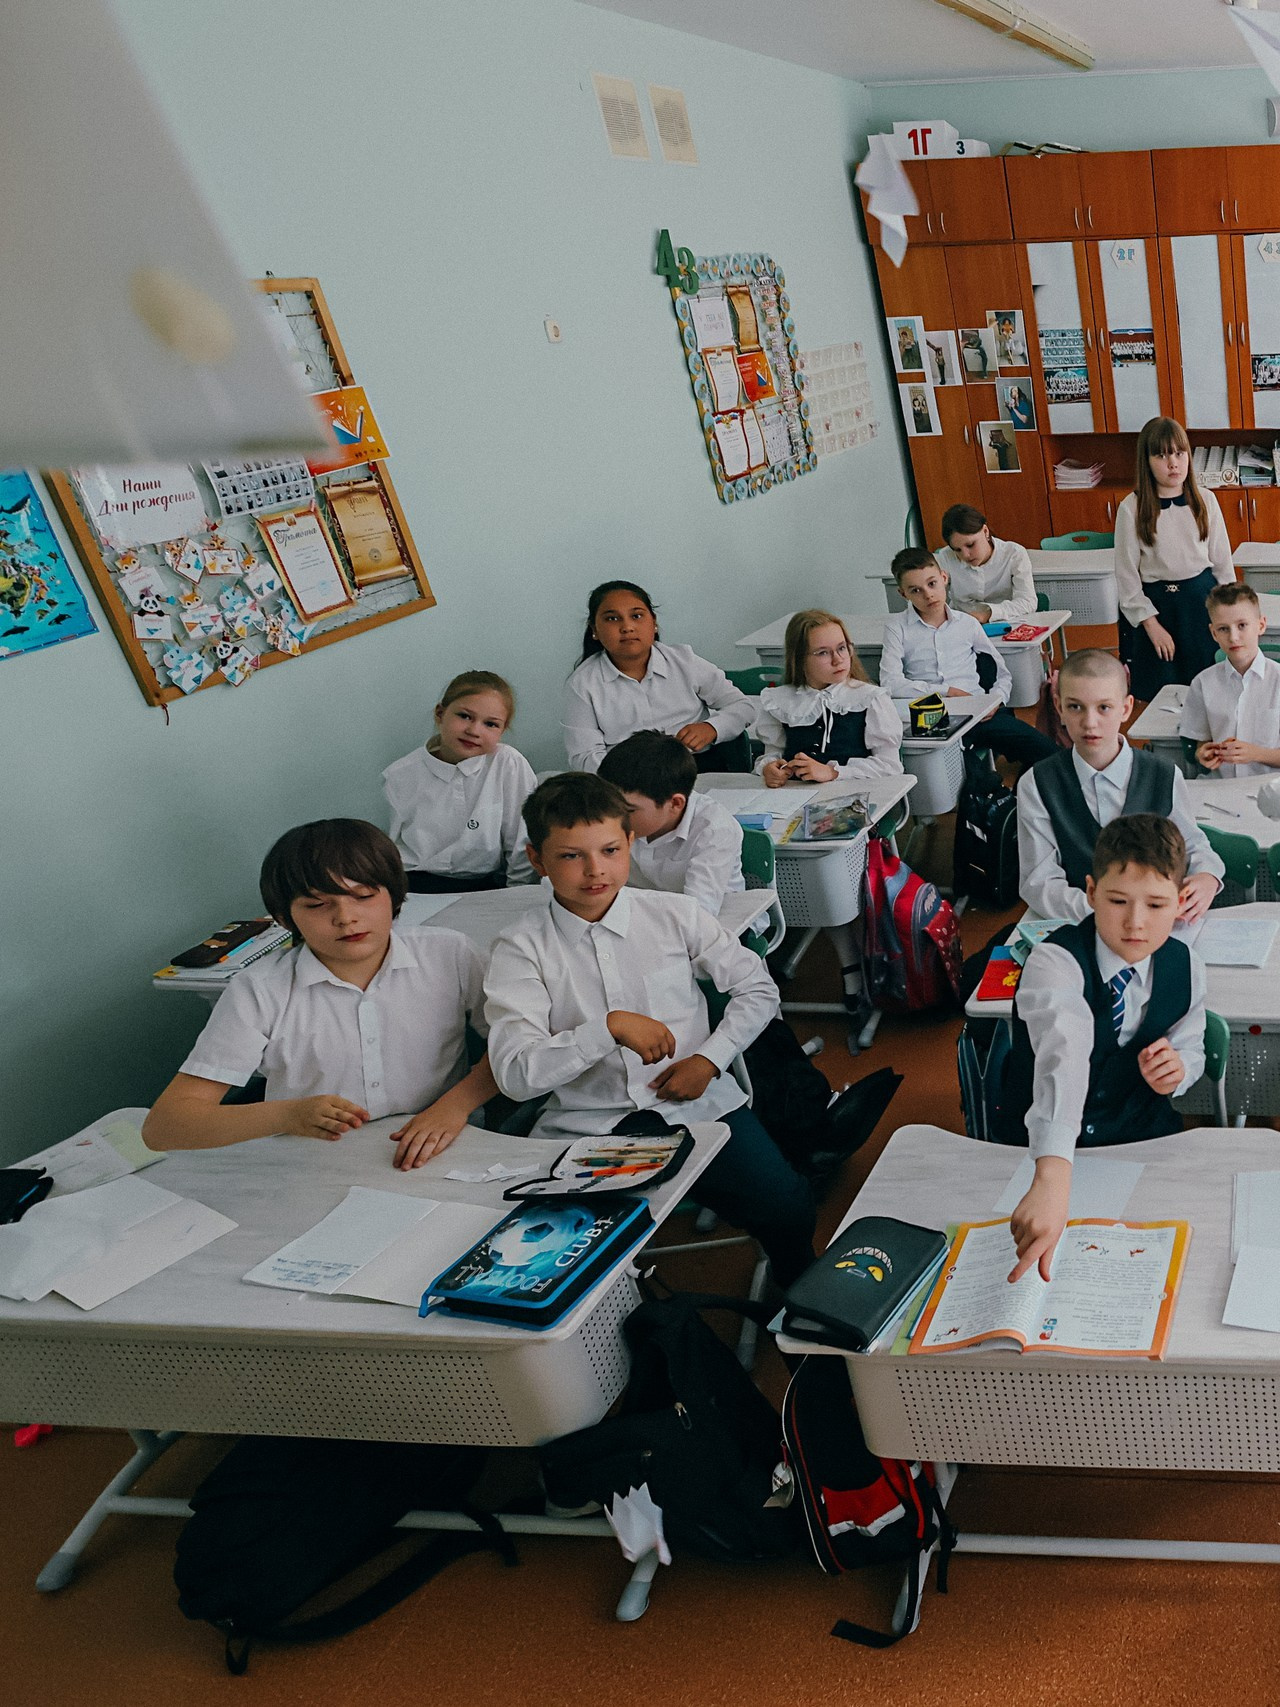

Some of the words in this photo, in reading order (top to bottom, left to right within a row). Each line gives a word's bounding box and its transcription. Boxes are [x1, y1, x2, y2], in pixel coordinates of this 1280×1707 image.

[956, 141, 965, 155] 3
[122, 479, 162, 494] Наши
[98, 500, 128, 517] Дни
[132, 490, 196, 515] рождения
[555, 1223, 602, 1268] CLUB
